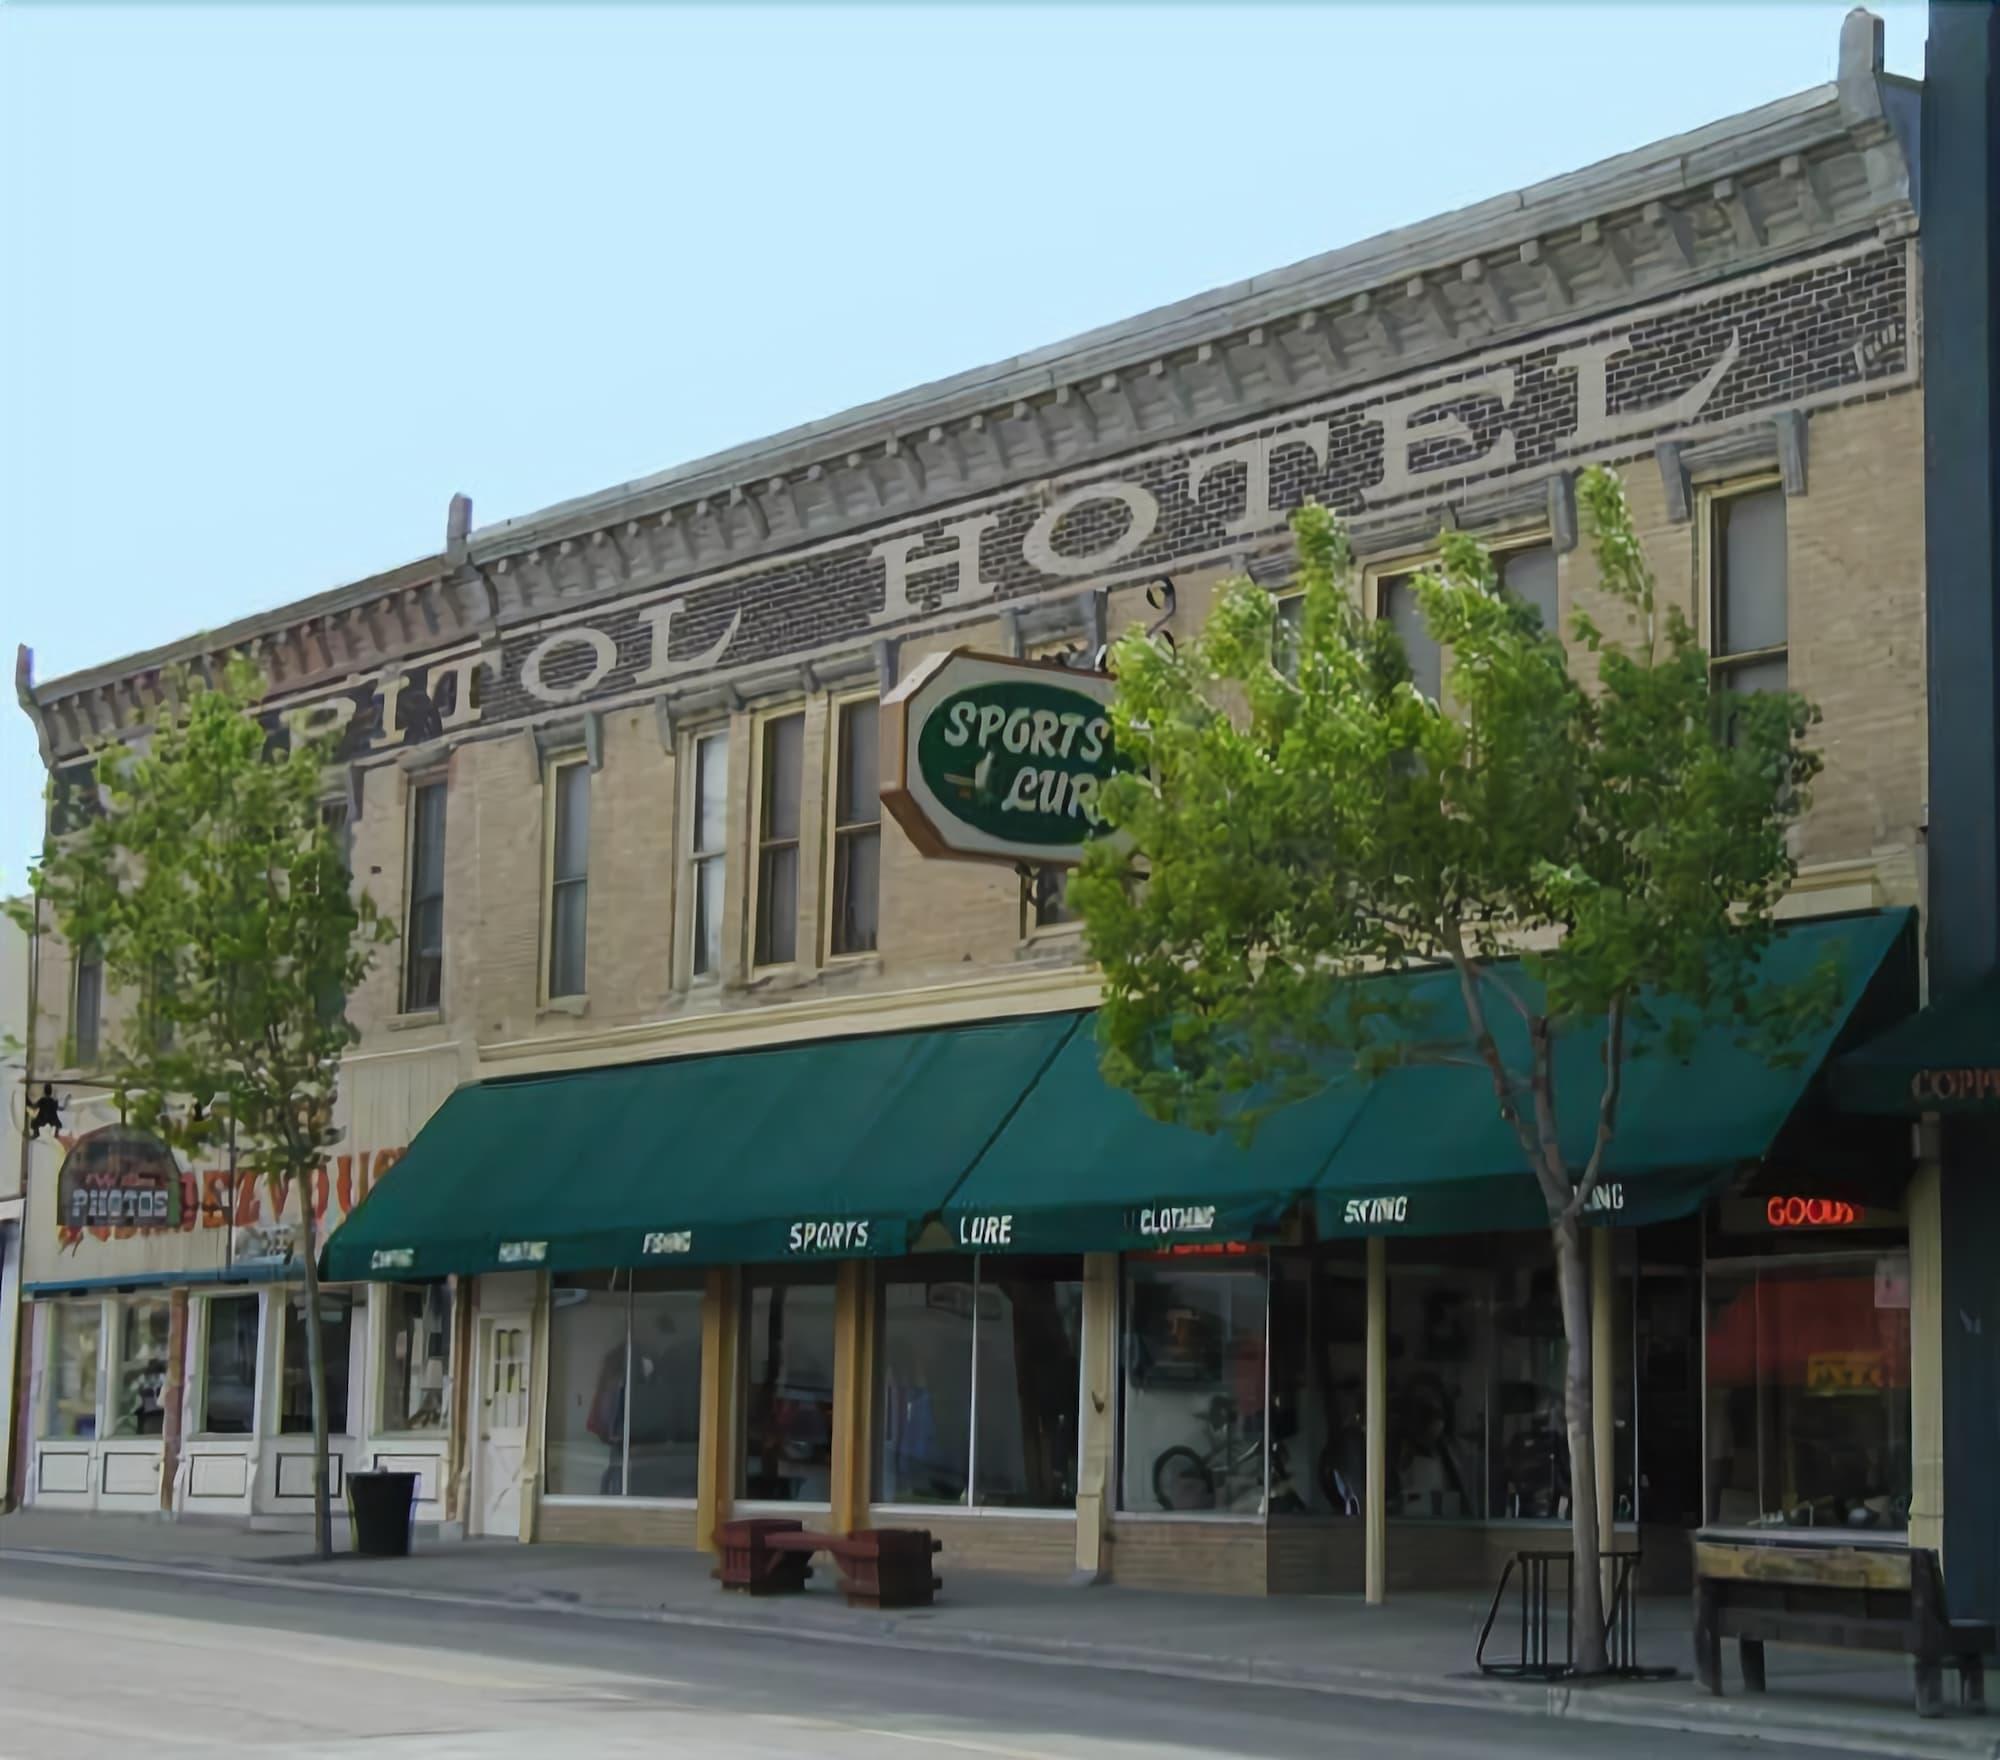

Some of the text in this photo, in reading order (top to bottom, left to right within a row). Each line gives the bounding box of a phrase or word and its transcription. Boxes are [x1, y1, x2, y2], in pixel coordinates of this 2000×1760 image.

[868, 326, 1741, 627] HOTEL
[943, 701, 1110, 762] SPORTS
[1000, 766, 1104, 827] LUR
[1911, 1068, 2000, 1100] COPP
[789, 1214, 1012, 1251] SPORTS LURE
